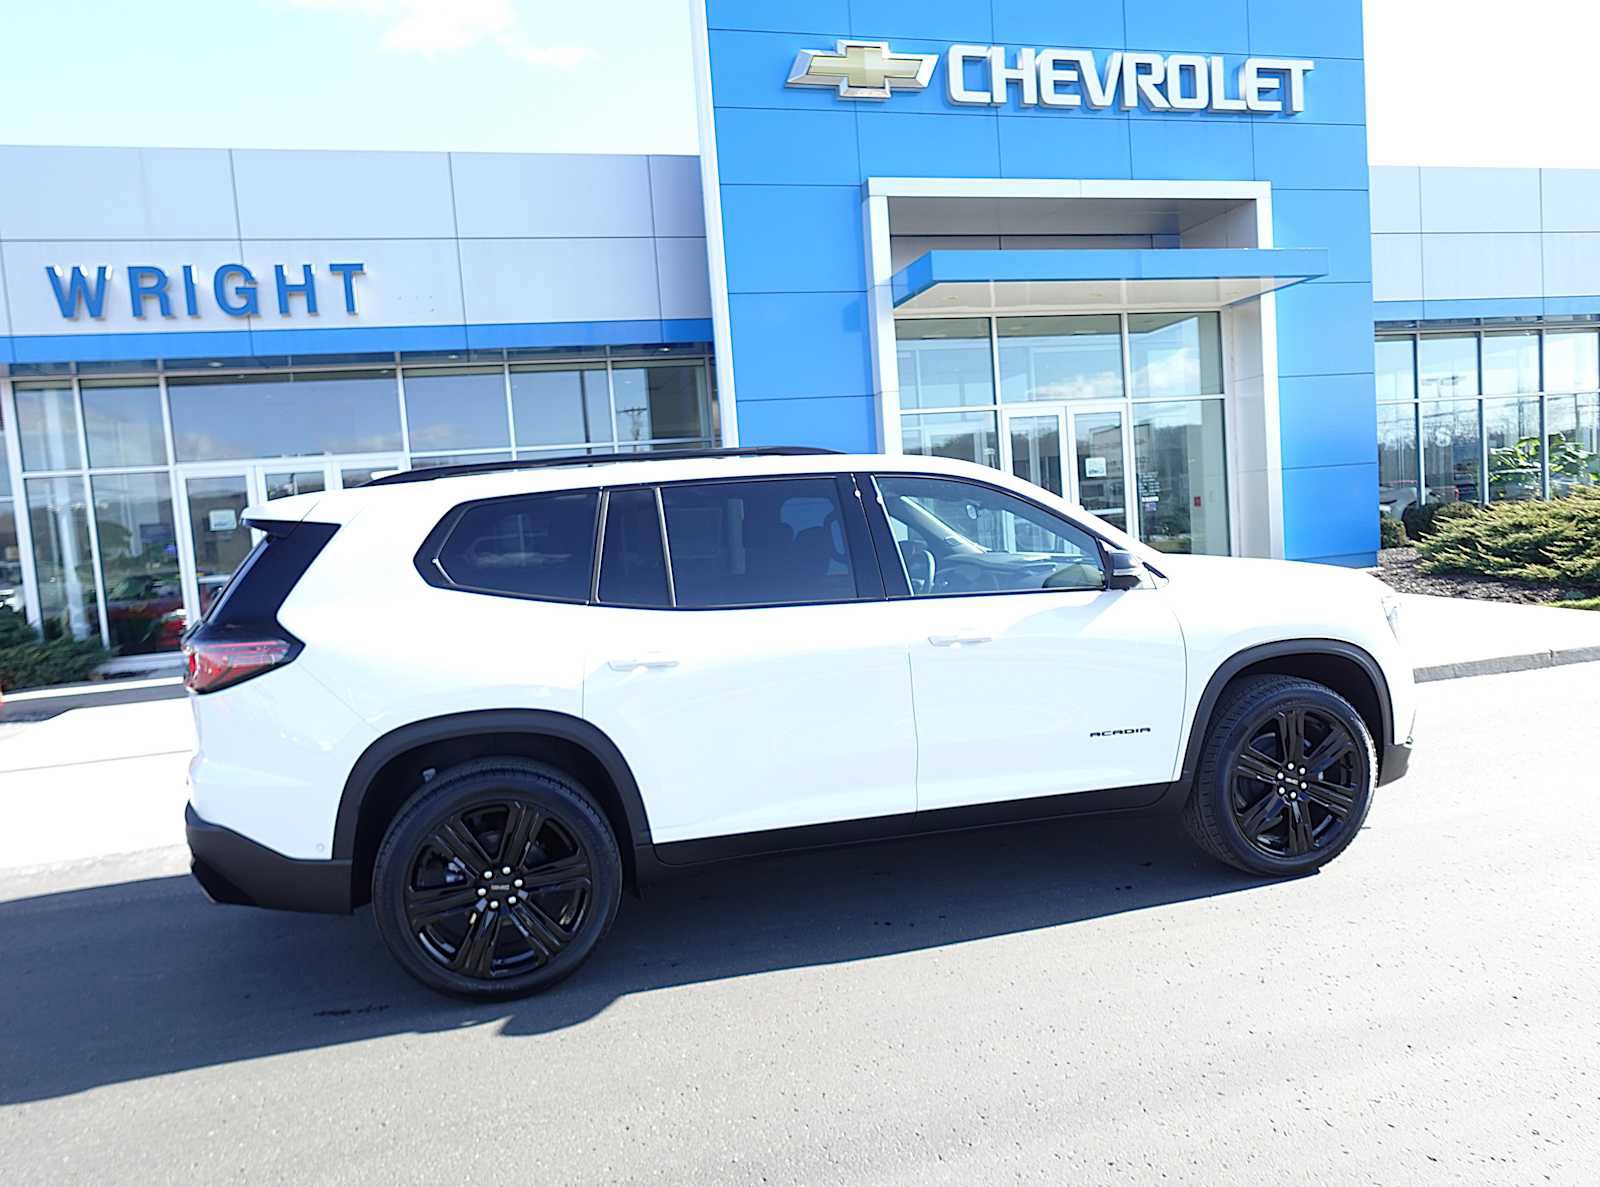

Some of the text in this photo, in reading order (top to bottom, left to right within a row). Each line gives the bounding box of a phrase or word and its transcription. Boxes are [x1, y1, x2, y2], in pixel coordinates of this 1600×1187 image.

[948, 44, 1314, 112] CHEVROLET
[46, 263, 365, 319] WRIGHT
[1090, 728, 1150, 737] ACADIA
